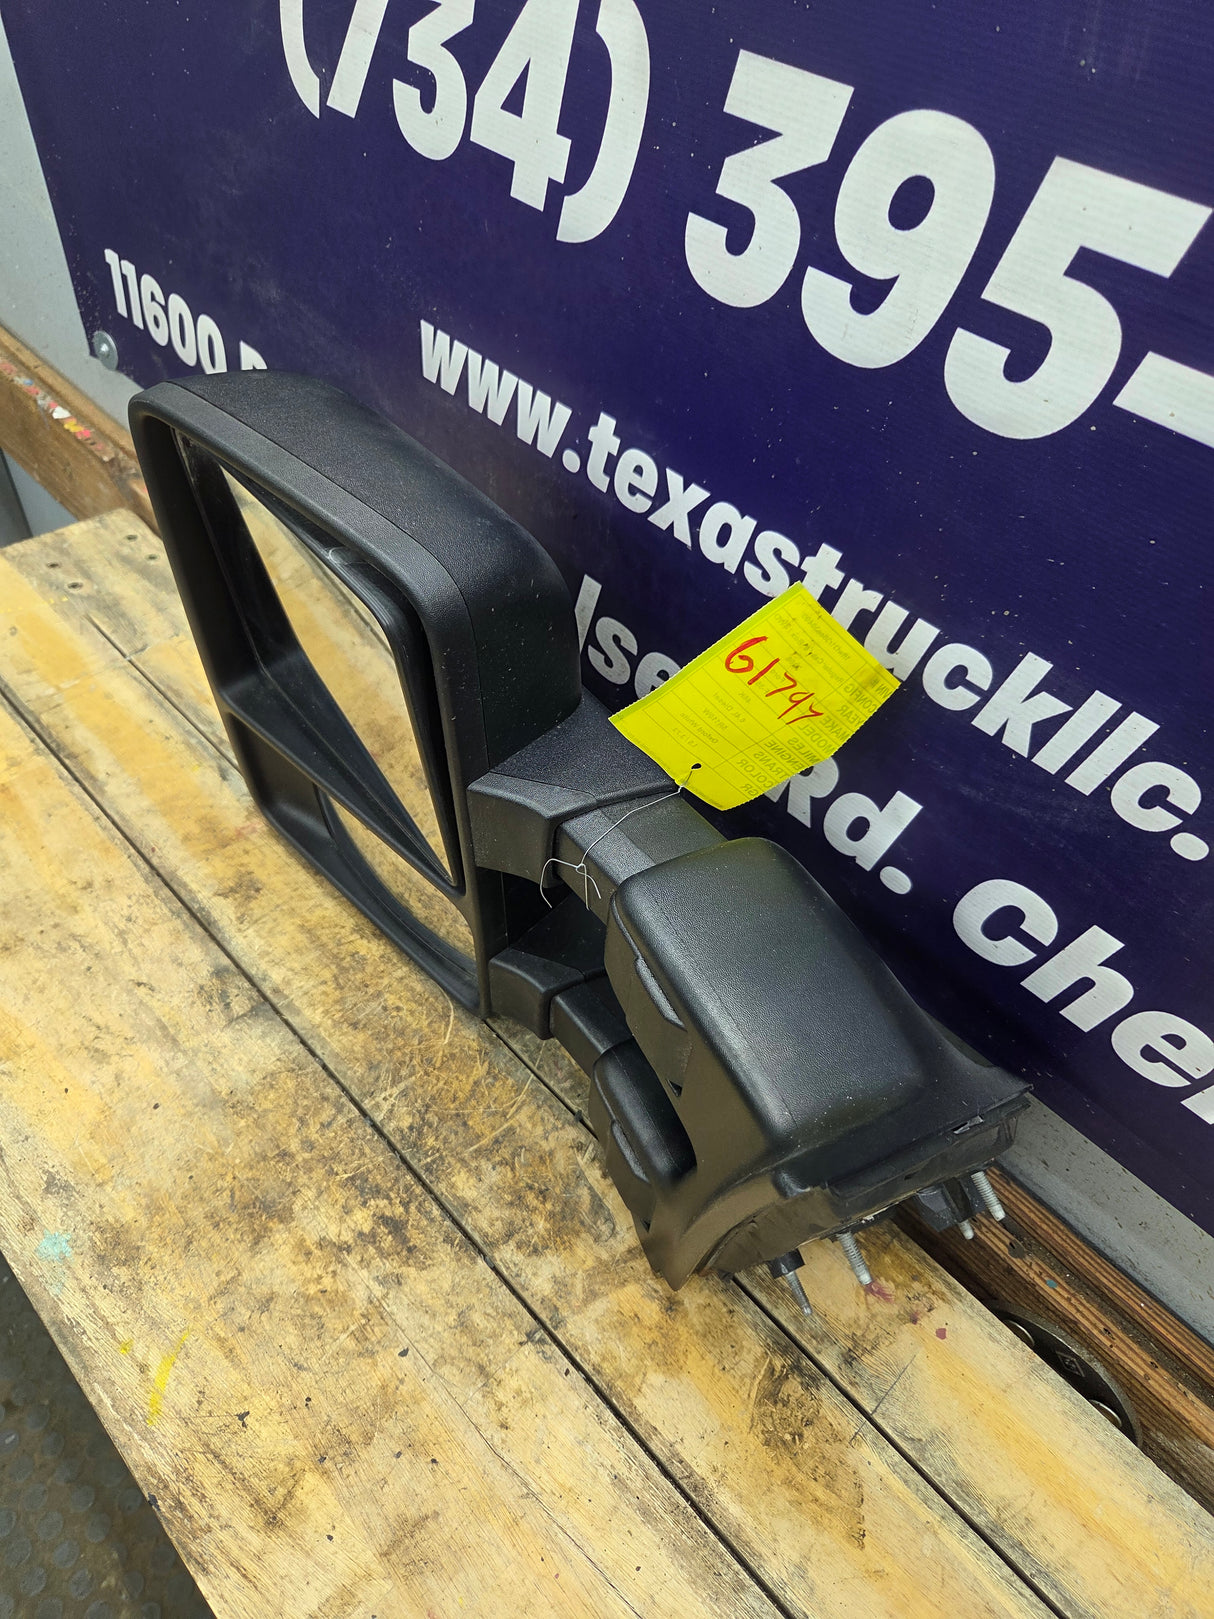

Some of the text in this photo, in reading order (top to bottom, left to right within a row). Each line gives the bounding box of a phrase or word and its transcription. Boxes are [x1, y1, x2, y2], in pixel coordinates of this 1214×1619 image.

[104, 249, 228, 375] 11600
[763, 755, 913, 895] Rd.
[952, 878, 1214, 1125] Che
